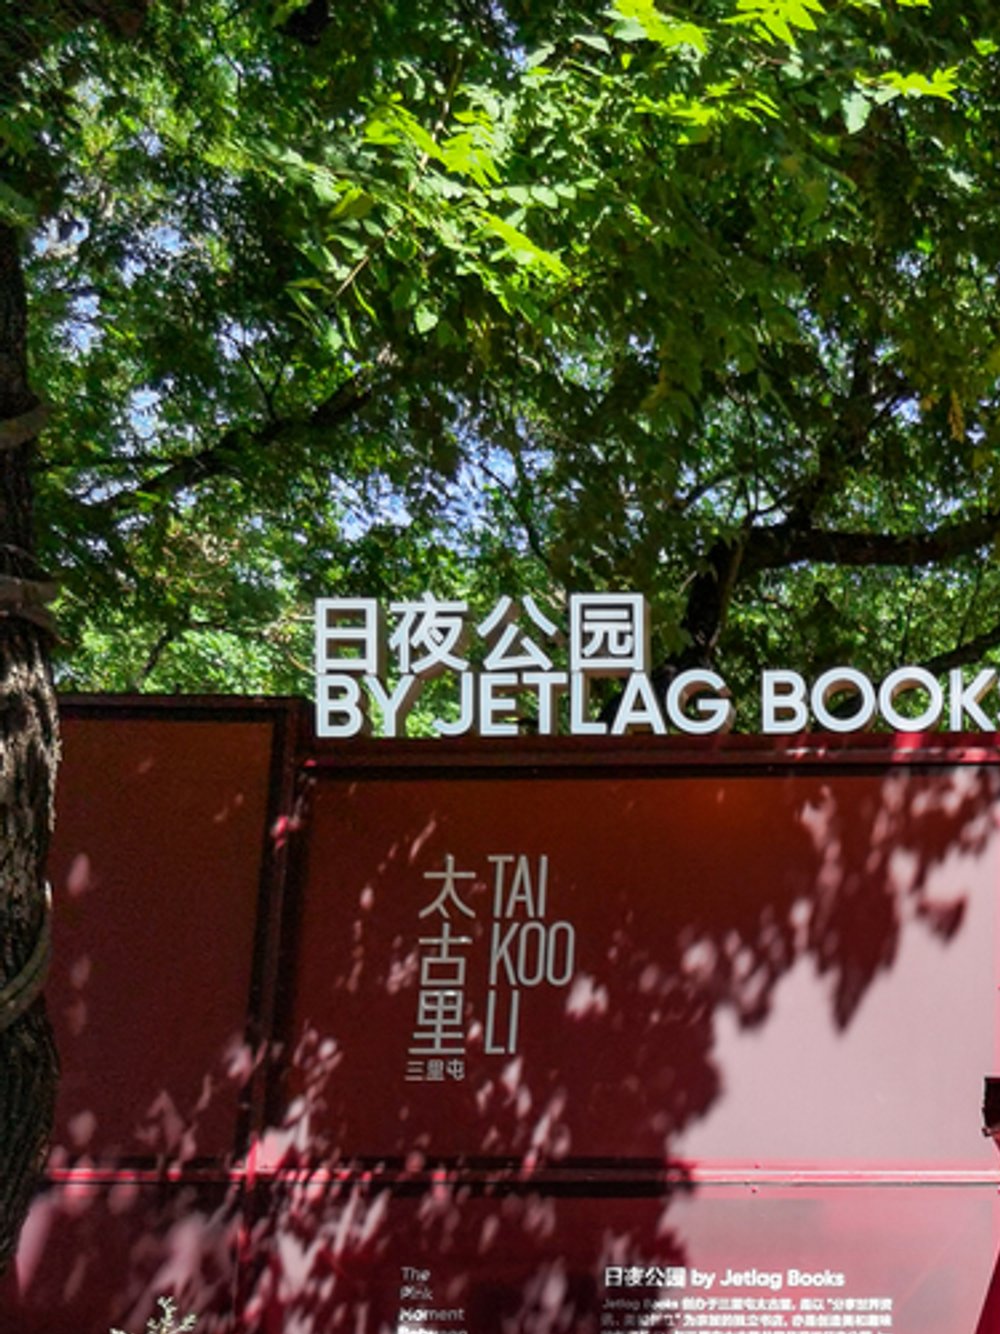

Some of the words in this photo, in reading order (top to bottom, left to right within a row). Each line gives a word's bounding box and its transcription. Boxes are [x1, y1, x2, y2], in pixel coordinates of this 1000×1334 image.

[315, 591, 645, 674] 日夜公园
[315, 672, 416, 738] BY
[432, 667, 732, 736] JETLAG
[487, 855, 548, 918] TAI
[408, 853, 476, 1055] 太古里
[488, 921, 575, 986] KOO
[484, 989, 520, 1055] LI
[404, 1058, 465, 1081] 三里屯
[401, 1266, 431, 1281] The
[605, 1267, 687, 1288] 日夜公园
[691, 1270, 715, 1289] by
[720, 1269, 783, 1290] Jetlag
[787, 1270, 845, 1288] Books
[400, 1308, 465, 1321] Moment
